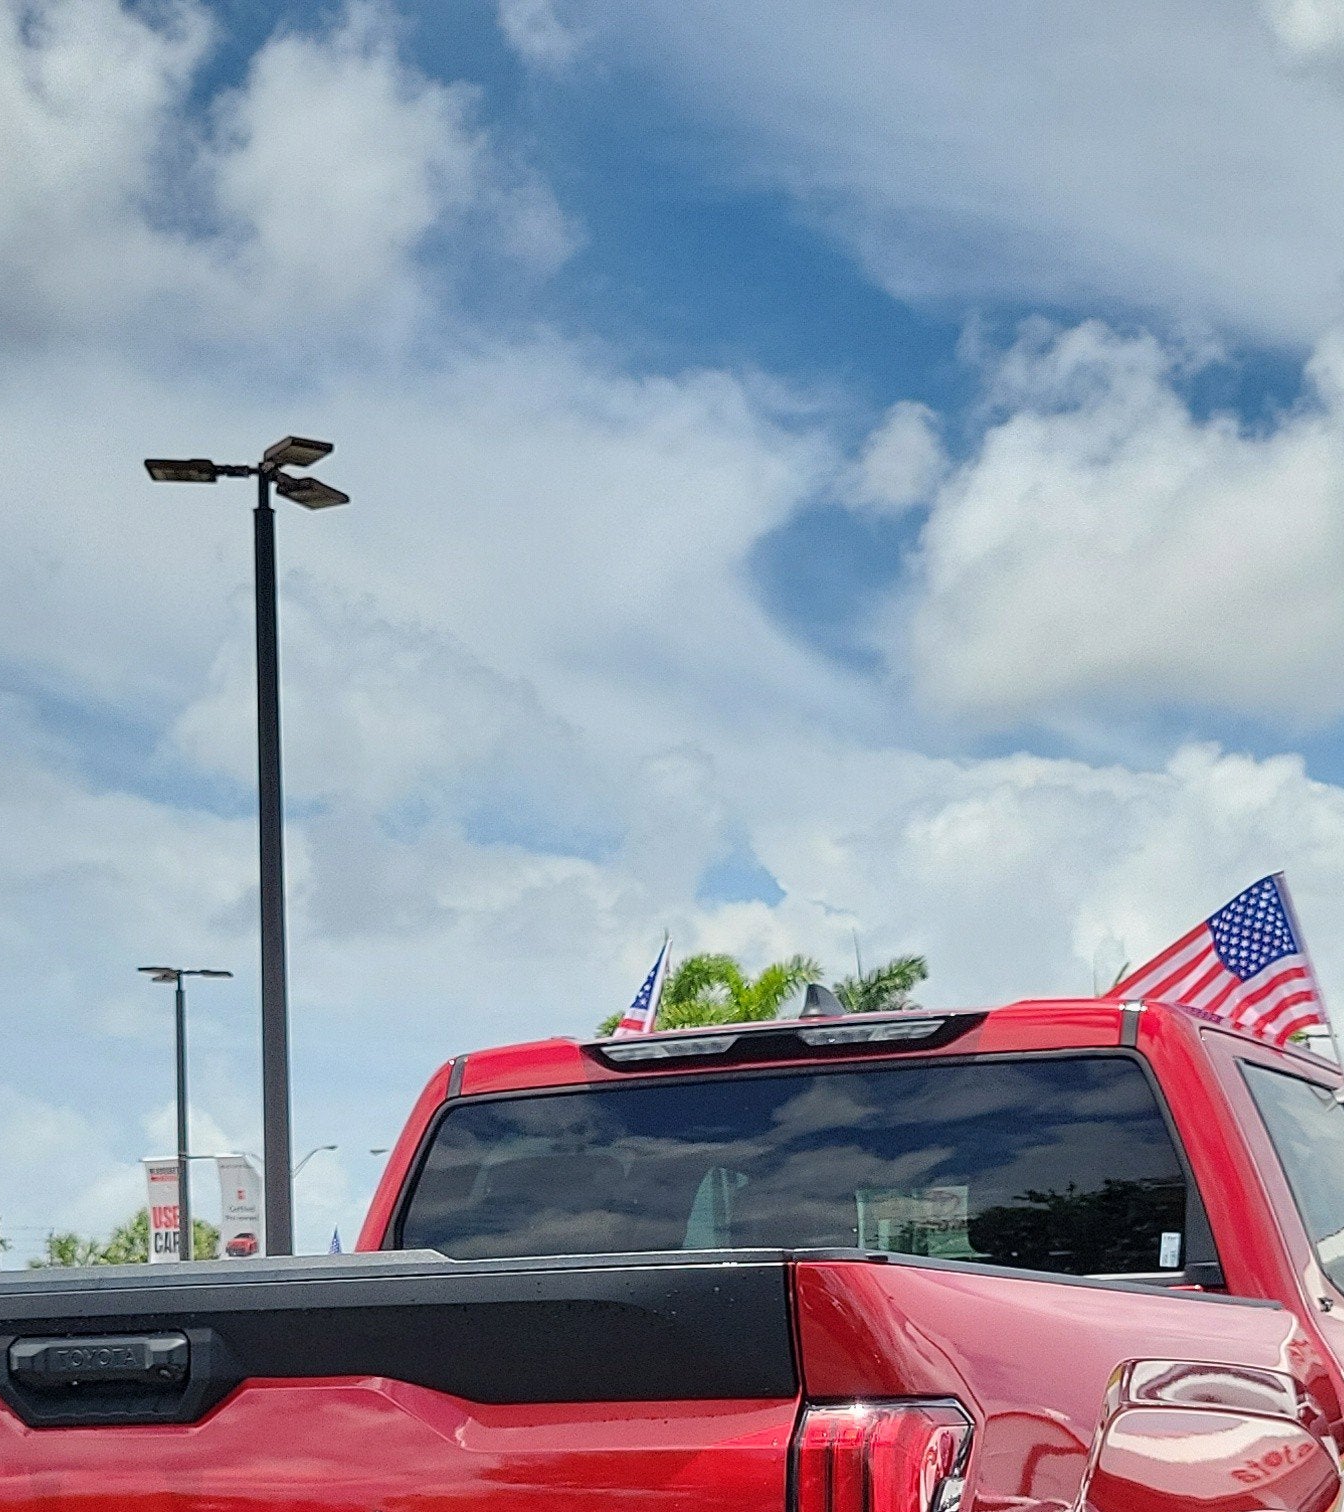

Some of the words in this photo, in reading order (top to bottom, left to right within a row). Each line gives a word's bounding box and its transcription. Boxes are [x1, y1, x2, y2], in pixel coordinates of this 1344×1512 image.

[152, 1206, 179, 1229] USE
[154, 1232, 179, 1253] CAR
[57, 1348, 137, 1368] TOYOTA
